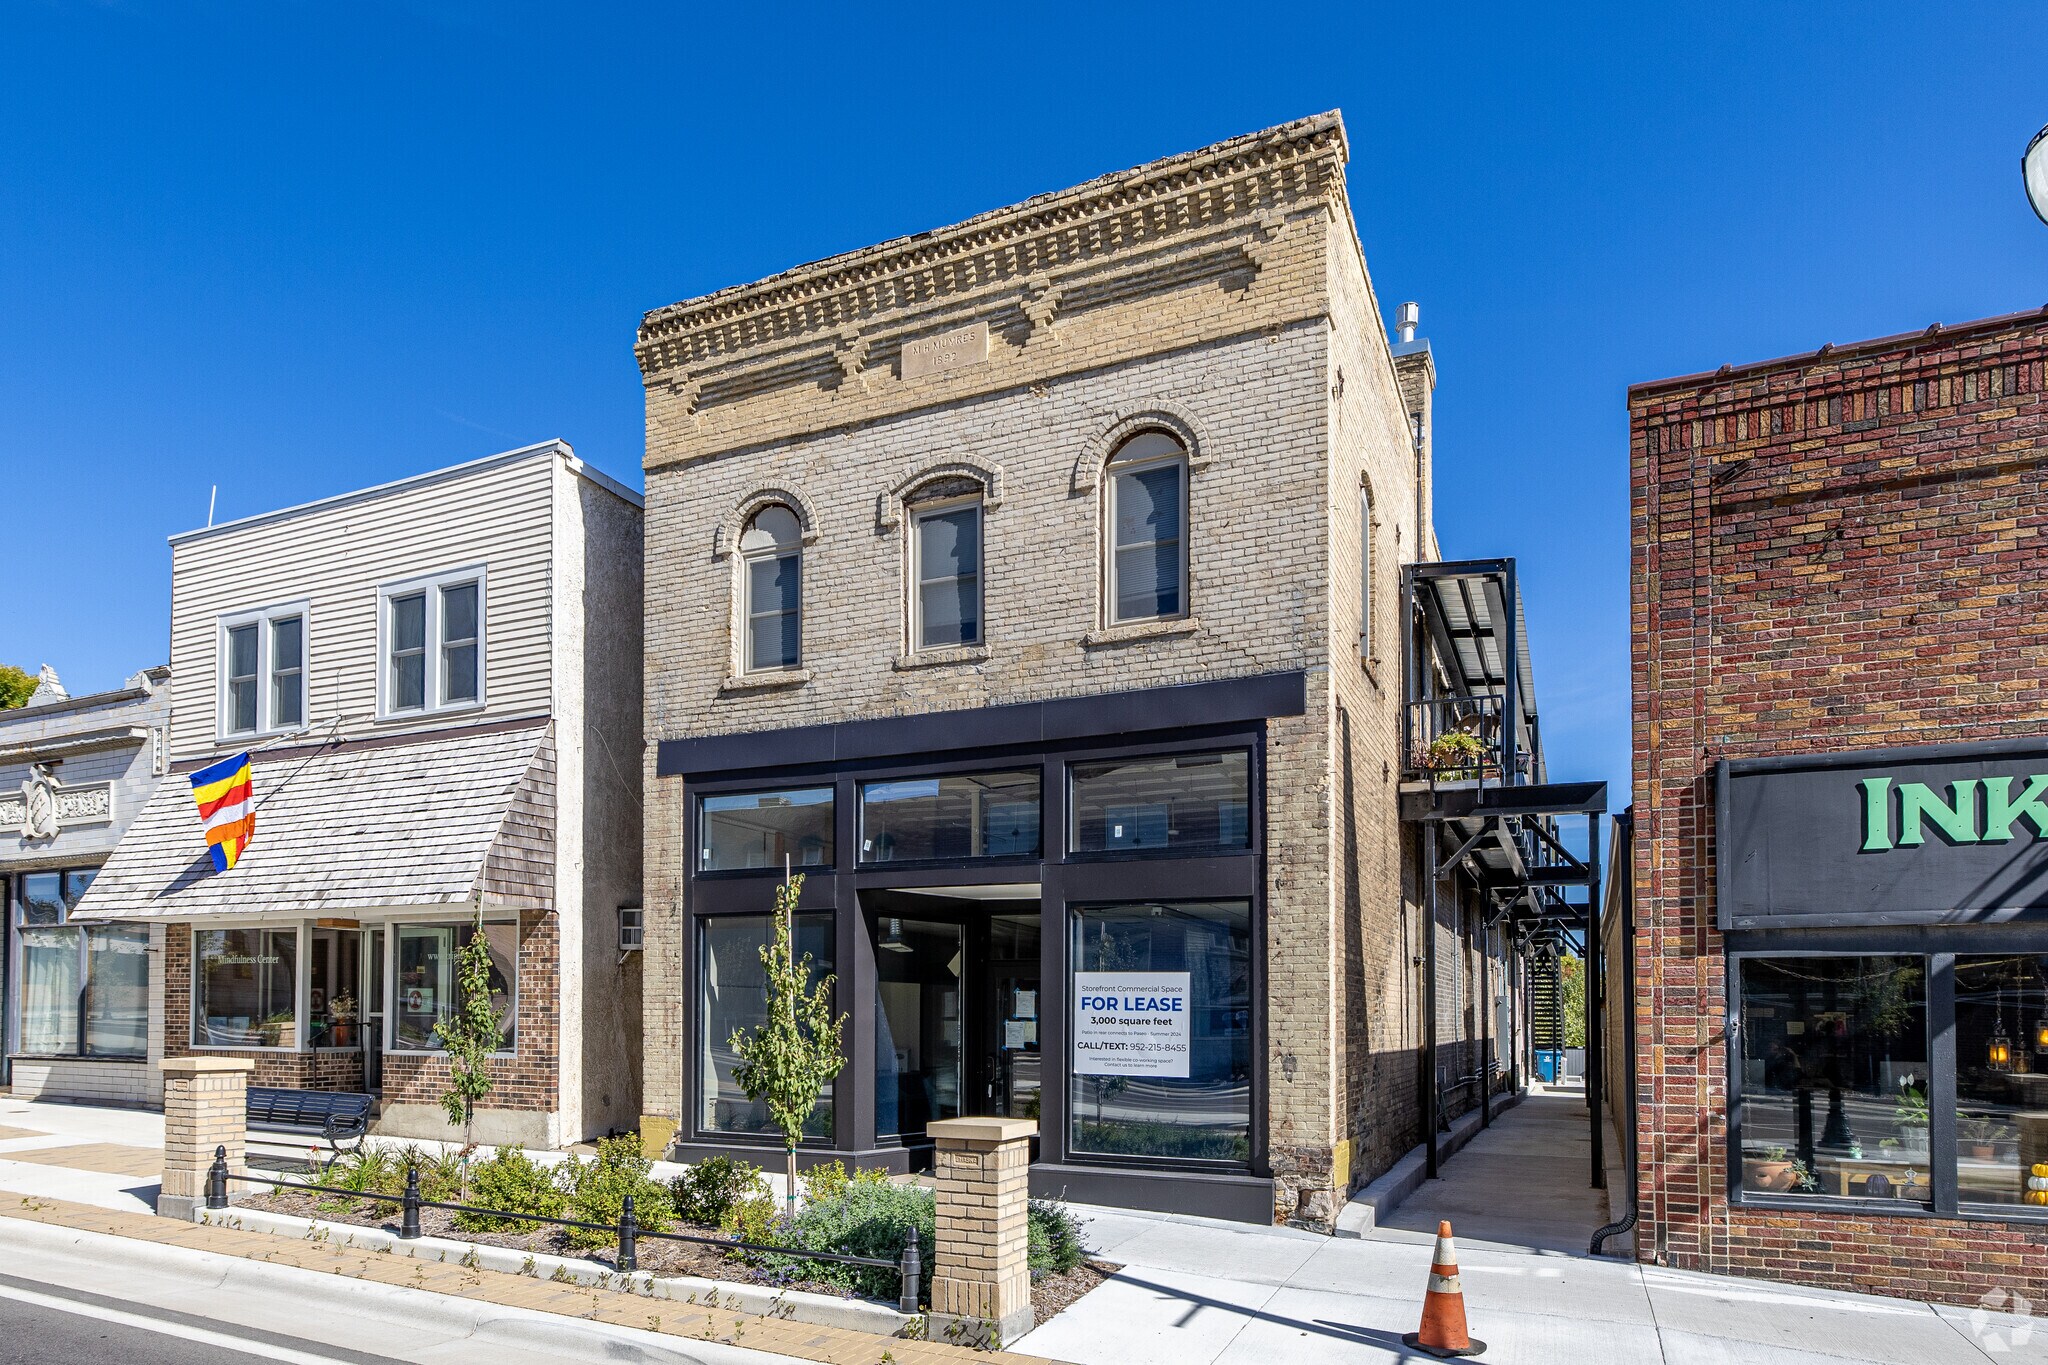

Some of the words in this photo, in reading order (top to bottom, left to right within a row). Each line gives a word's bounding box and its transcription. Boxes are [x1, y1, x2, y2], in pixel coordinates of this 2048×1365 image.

[218, 954, 256, 964] Mindfulness
[257, 954, 279, 964] Center
[1117, 985, 1159, 993] Commercial
[1160, 985, 1183, 994] Space
[1081, 996, 1119, 1011] FOR
[1124, 997, 1183, 1012] LEASE
[1090, 1016, 1117, 1026] 3,000
[1118, 1018, 1151, 1027] square
[1153, 1017, 1173, 1026] feet
[1077, 1041, 1129, 1051] CALL/TEXT:
[1129, 1042, 1187, 1053] 952-215-8455
